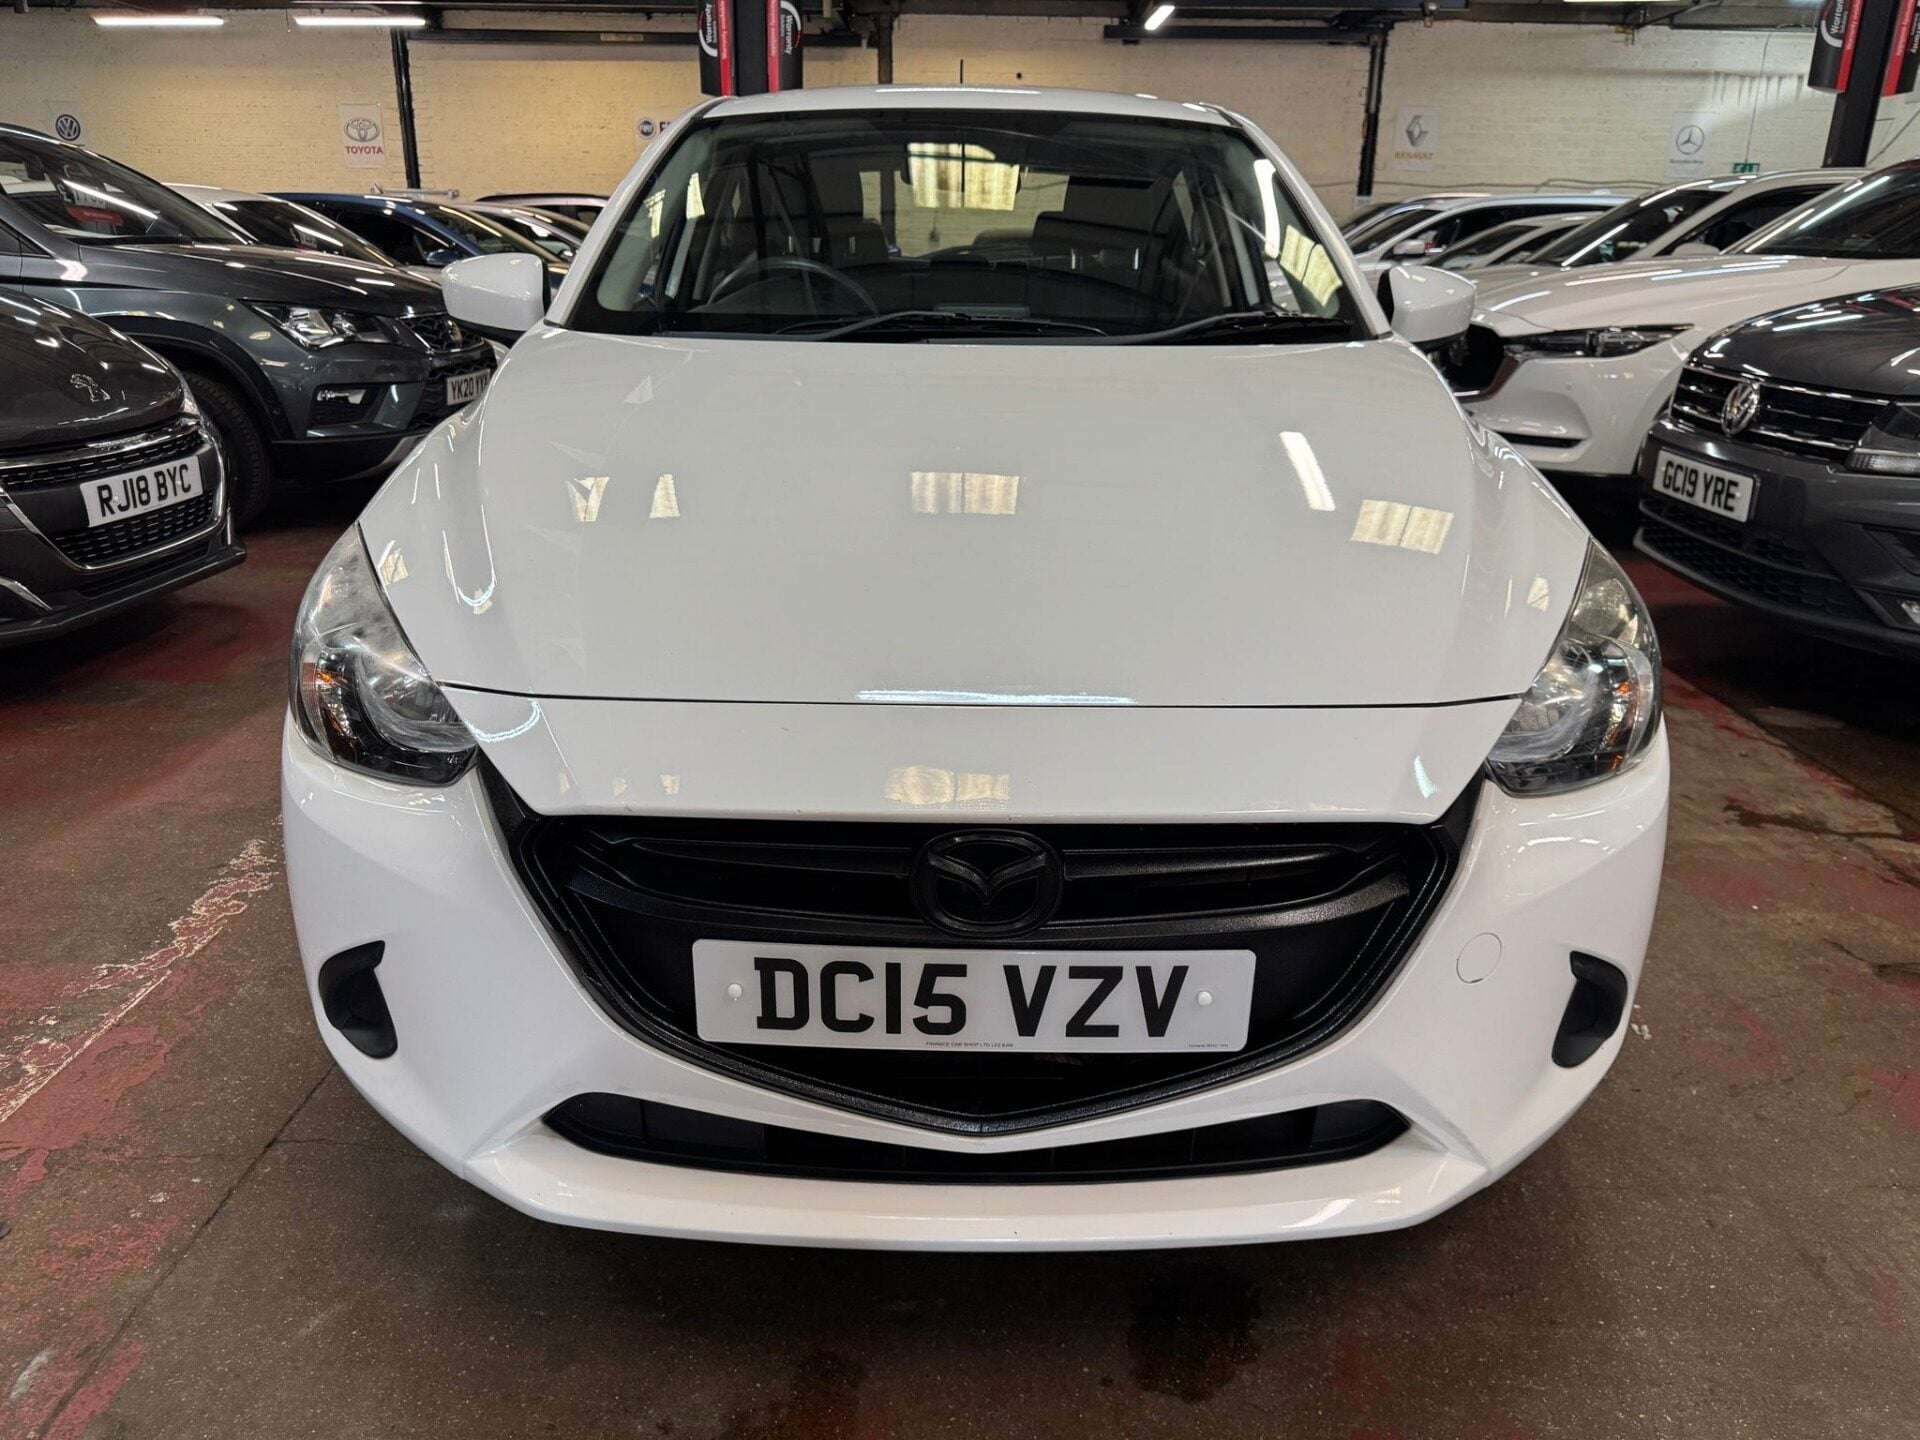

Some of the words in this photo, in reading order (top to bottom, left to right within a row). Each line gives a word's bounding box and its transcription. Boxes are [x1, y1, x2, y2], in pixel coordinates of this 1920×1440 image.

[705, 3, 713, 44] Warranty
[785, 15, 793, 55] Warranty
[344, 145, 384, 155] TOYOTA
[451, 376, 475, 401] YK20
[97, 475, 151, 517] RJ18
[154, 463, 191, 502] BYC
[1662, 460, 1699, 498] GC19
[1702, 472, 1739, 512] YRE
[753, 957, 968, 1036] DC15
[1003, 965, 1189, 1038] VZV
